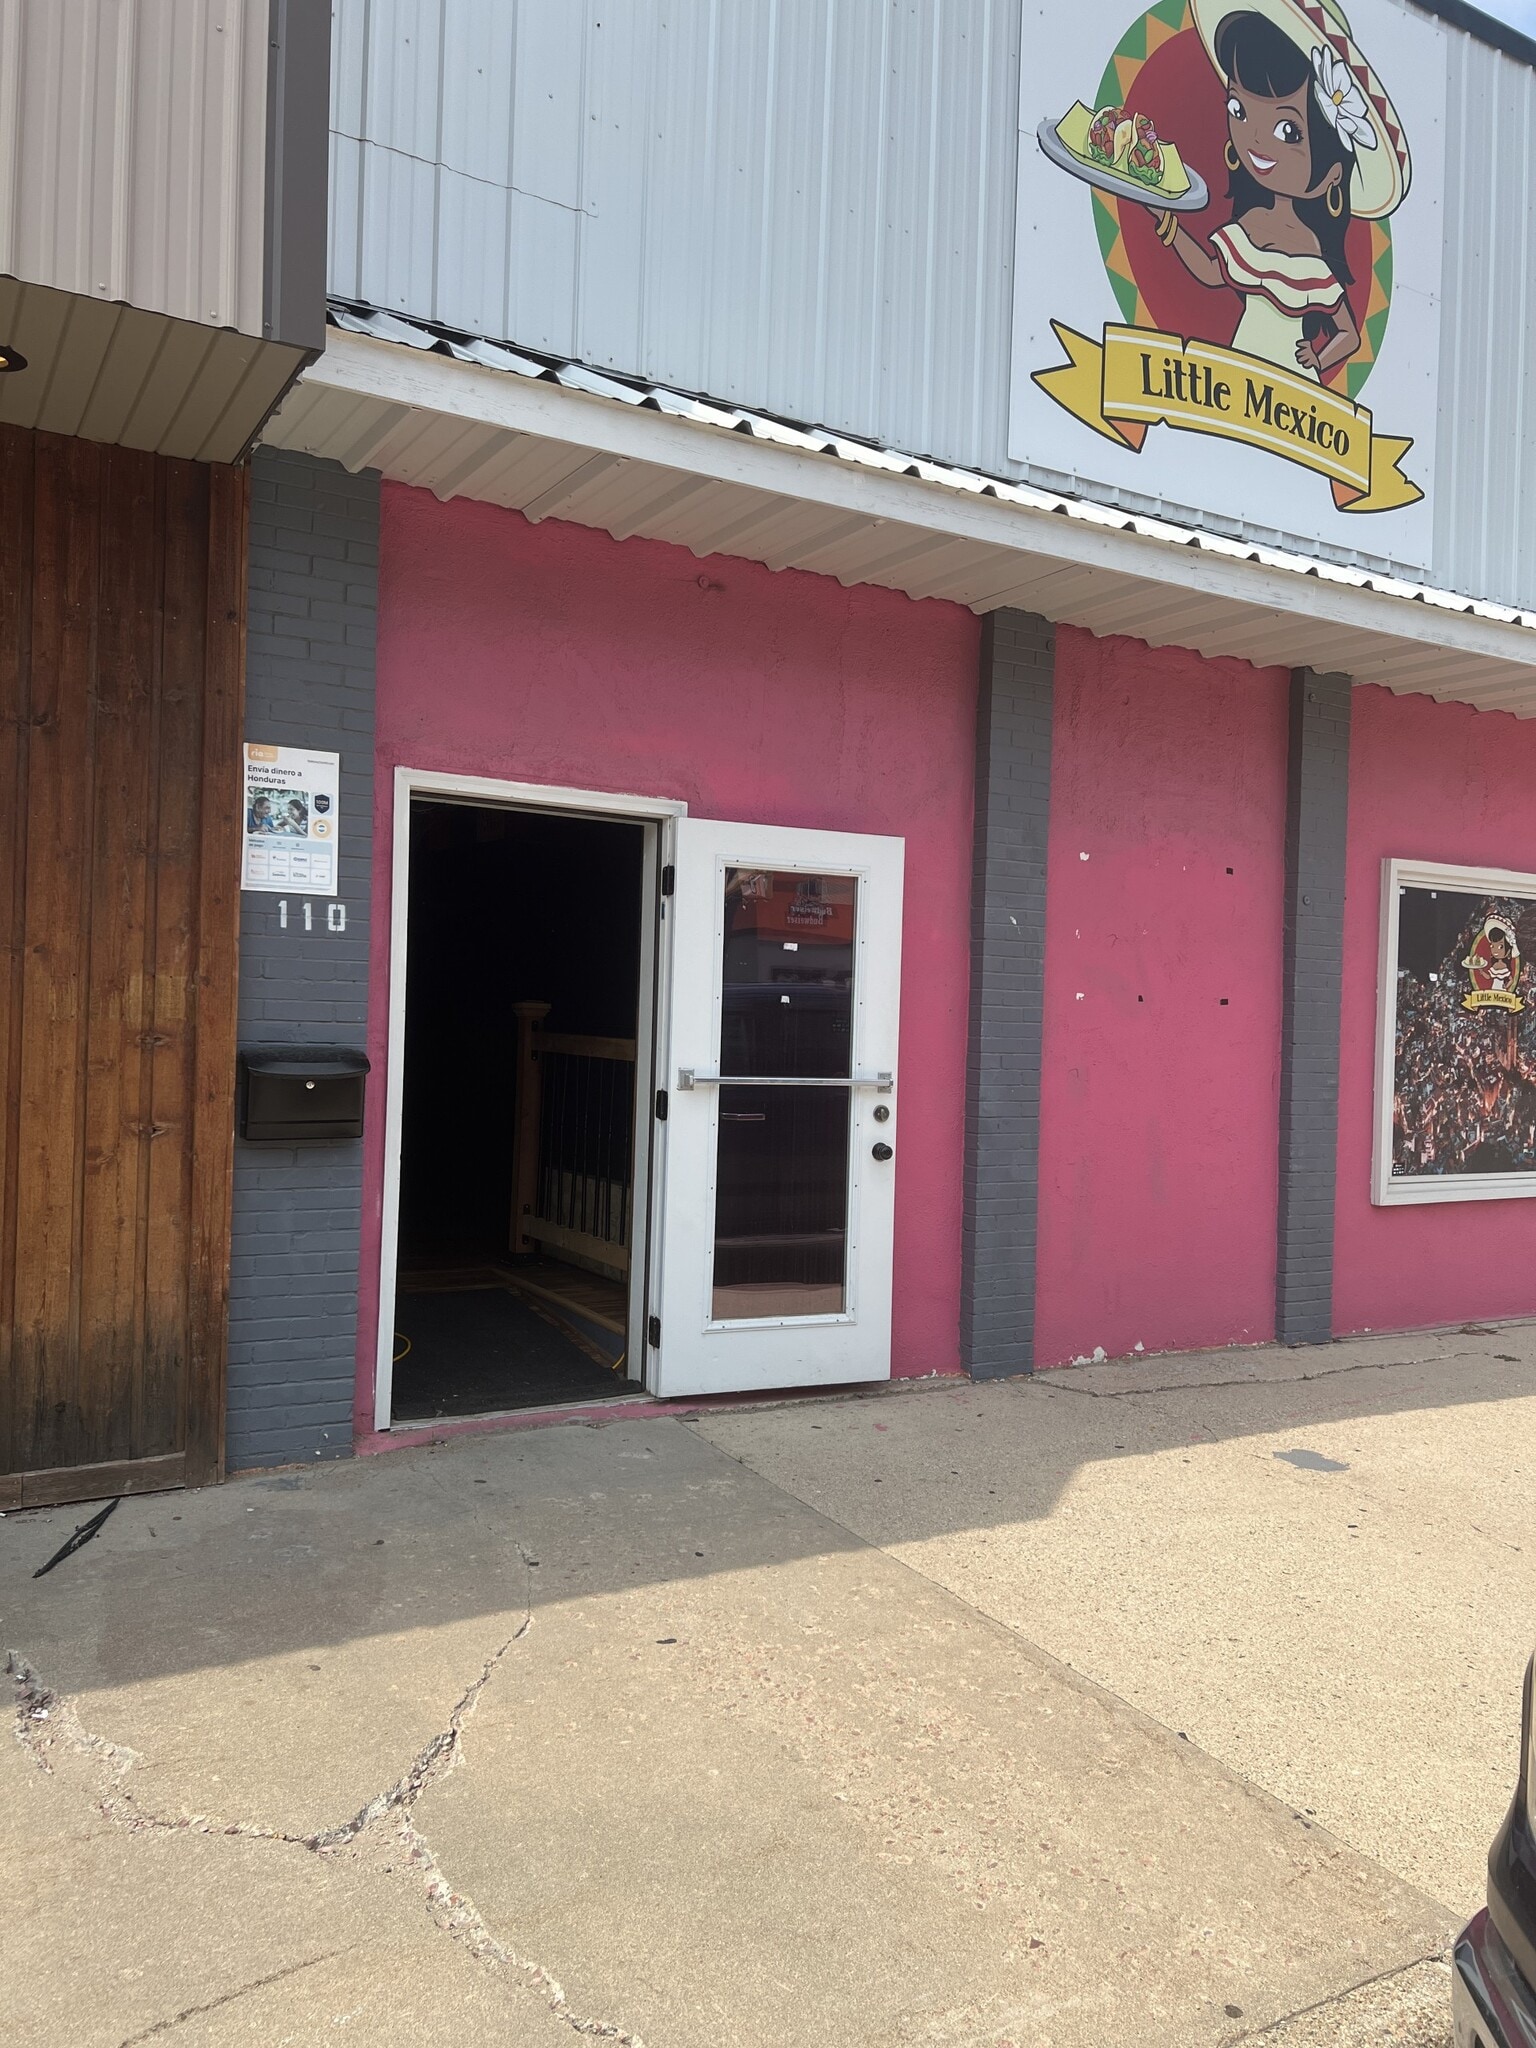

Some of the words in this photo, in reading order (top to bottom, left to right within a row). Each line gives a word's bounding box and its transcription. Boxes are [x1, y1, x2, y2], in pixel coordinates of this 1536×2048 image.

[1140, 353, 1231, 411] Little
[1244, 378, 1350, 456] Mexico
[271, 767, 296, 776] dinero
[248, 774, 286, 785] Honduras
[278, 900, 346, 932] 110
[1476, 993, 1491, 1002] Little
[1493, 993, 1513, 1004] Mexico
